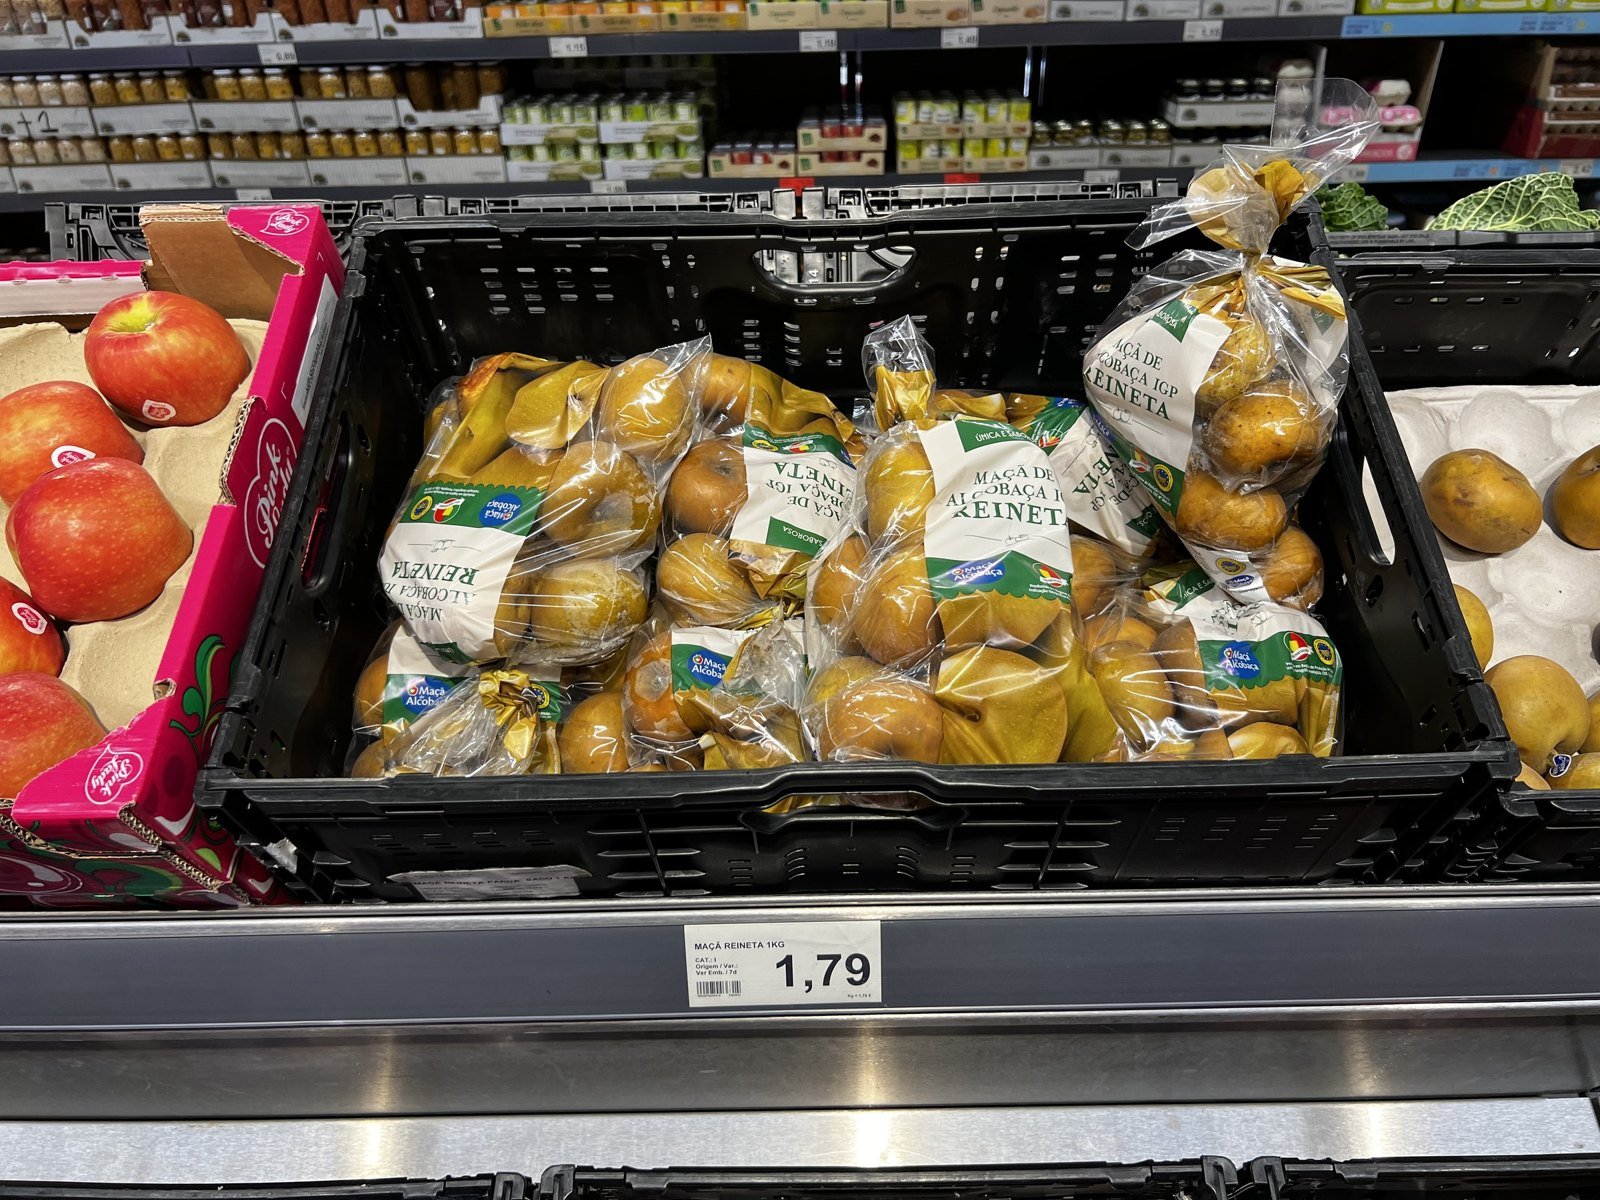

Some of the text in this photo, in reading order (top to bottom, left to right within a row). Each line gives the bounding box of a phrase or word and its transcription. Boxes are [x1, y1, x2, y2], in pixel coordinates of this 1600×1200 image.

[270, 221, 296, 233] Lady
[275, 213, 304, 226] Pink
[1142, 352, 1163, 371] DE
[1153, 379, 1178, 399] IGP
[975, 430, 1001, 442] ÚNICA
[974, 464, 1055, 485] MAÇÃ DE
[1072, 444, 1120, 495] NETA
[257, 442, 283, 550] Pink
[786, 495, 842, 522] AÇÃ DE
[782, 525, 824, 547] SABOROSA
[392, 561, 480, 587] REINETA
[400, 582, 476, 607] ALCOBAÇA
[406, 601, 443, 622] MAÇÃ
[704, 657, 727, 671] Maçã
[1233, 650, 1251, 662] Maçã
[691, 664, 723, 679] Alcoba
[405, 696, 436, 706] Alcob
[419, 686, 445, 698] Maçã
[91, 754, 122, 790] Lady
[100, 758, 133, 797] Pink
[694, 940, 785, 951] MAÇÃ REINETA 1KG
[775, 952, 871, 994] 1,79
